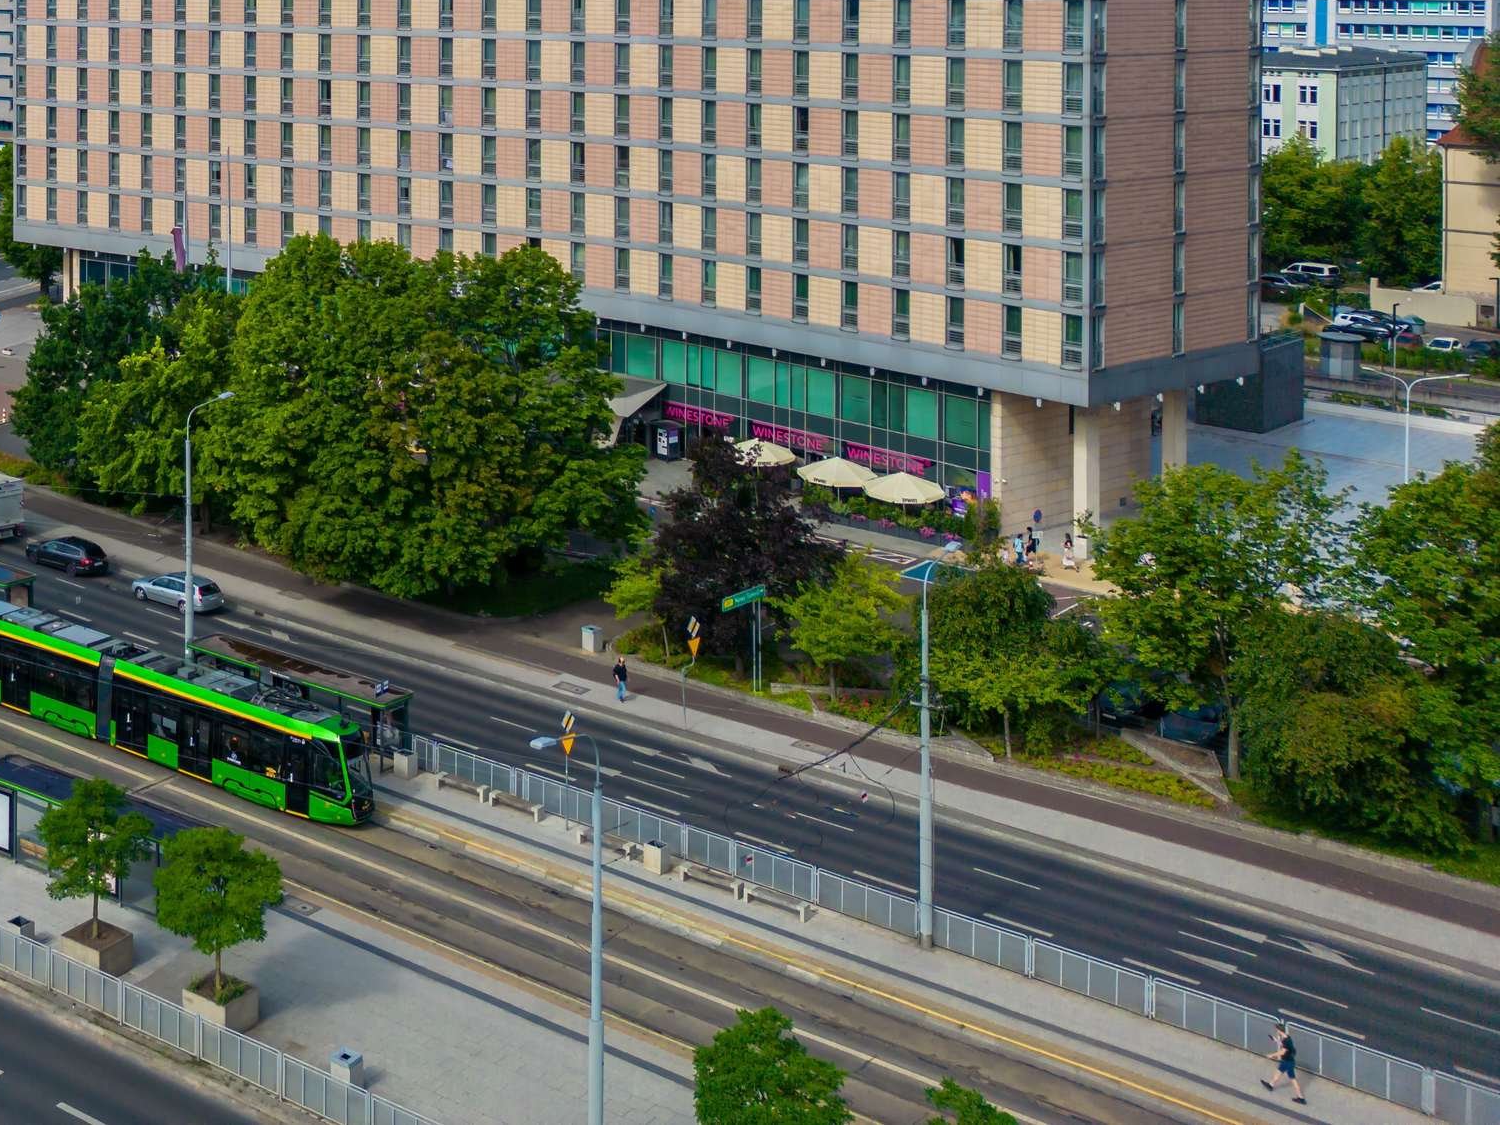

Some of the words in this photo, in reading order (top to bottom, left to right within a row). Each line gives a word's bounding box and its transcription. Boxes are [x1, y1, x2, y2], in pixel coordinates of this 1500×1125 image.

[667, 406, 730, 427] WINESTONE
[752, 424, 823, 450] WINESTONE
[846, 447, 925, 475] WINESTONE
